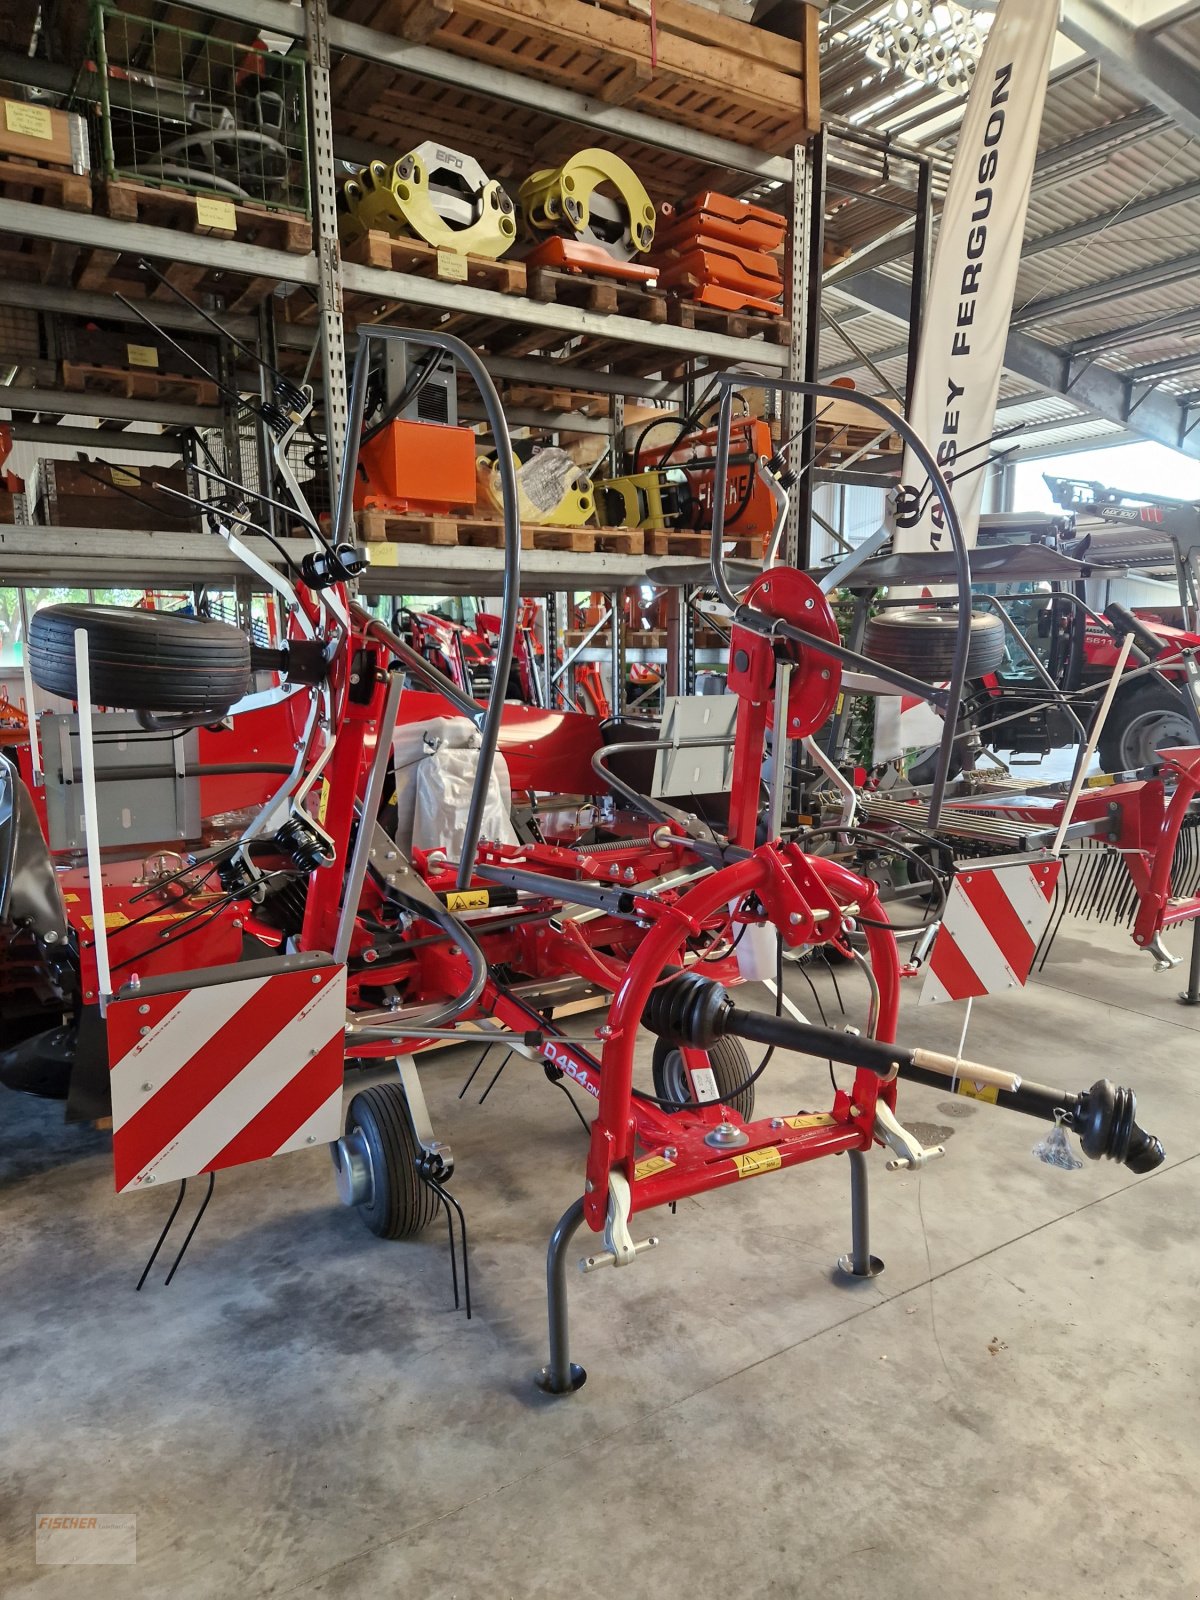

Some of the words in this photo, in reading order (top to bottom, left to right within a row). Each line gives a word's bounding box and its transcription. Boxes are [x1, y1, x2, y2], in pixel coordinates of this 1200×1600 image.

[951, 62, 1013, 356] FERGUSON
[556, 1055, 588, 1086] 454
[586, 1082, 600, 1097] DN
